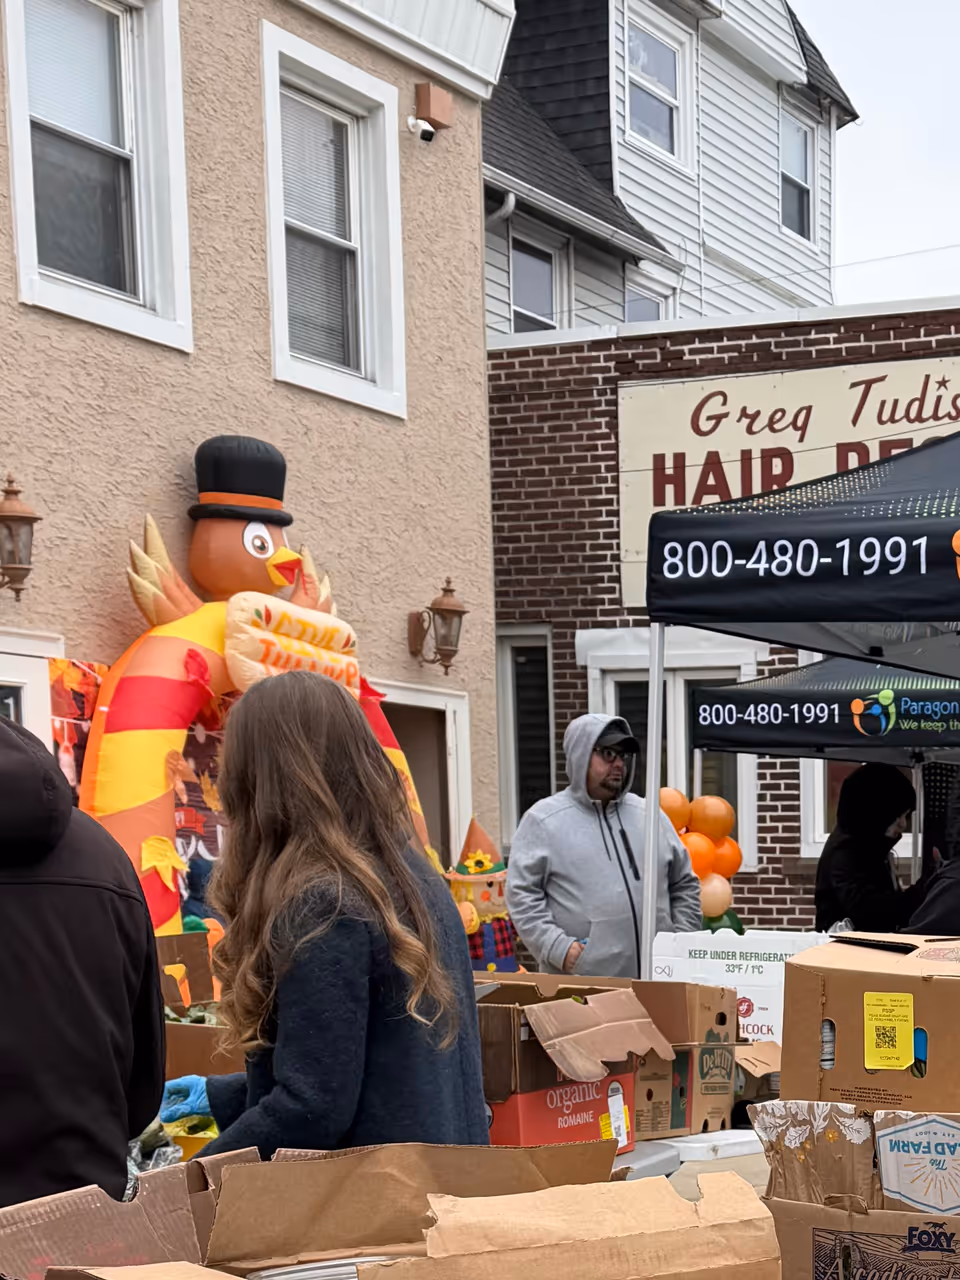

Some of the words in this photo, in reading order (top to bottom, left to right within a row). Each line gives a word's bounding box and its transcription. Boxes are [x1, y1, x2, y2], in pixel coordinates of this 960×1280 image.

[652, 446, 795, 507] HAIR
[662, 537, 929, 579] 800-480-1991
[699, 703, 840, 726] 800-480-1991
[901, 698, 959, 719] Paragon
[689, 949, 708, 959] KEEP
[710, 950, 737, 961] UNDER
[546, 1080, 601, 1110] organic
[557, 1111, 594, 1129] ROMAINE
[888, 1139, 931, 1154] FARM
[907, 1227, 956, 1248] FOXY
